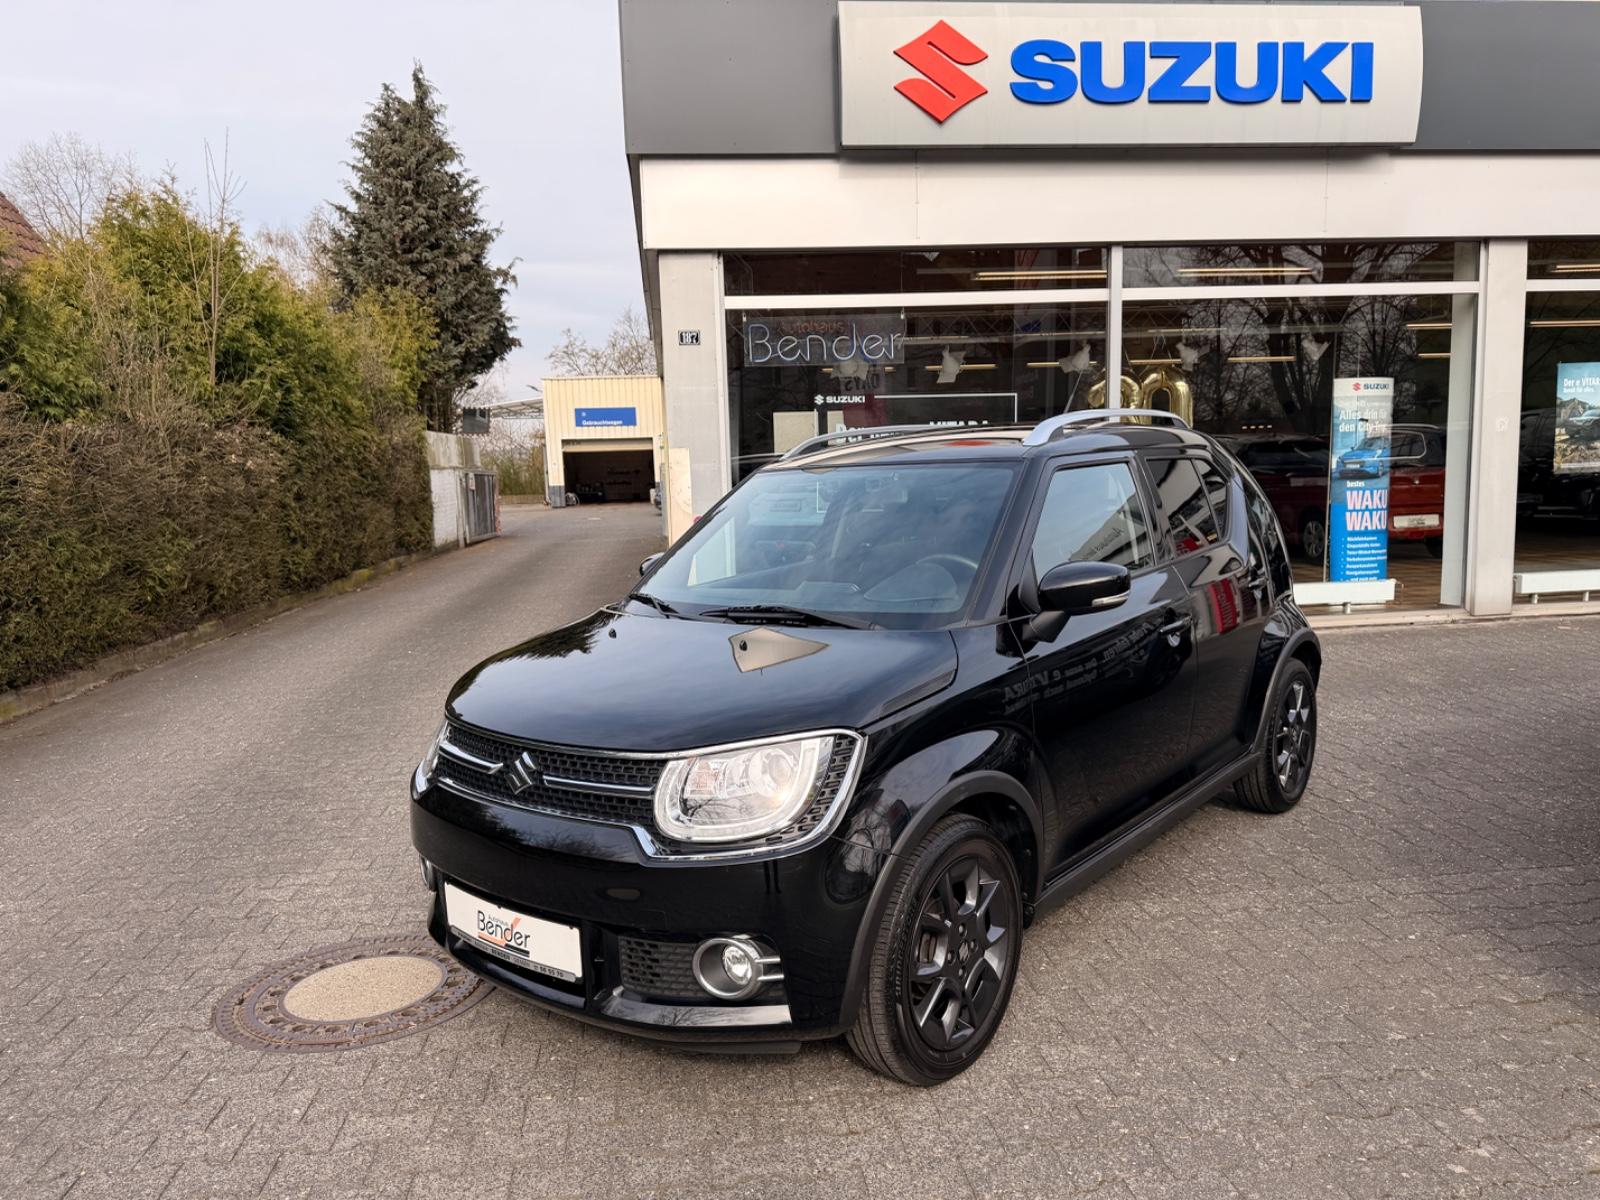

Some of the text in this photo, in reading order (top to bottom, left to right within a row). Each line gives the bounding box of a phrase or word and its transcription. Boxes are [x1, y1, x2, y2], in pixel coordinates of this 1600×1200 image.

[1009, 38, 1374, 105] SUZUKI
[748, 322, 903, 363] Bender
[825, 395, 866, 404] SUZUKI
[1339, 409, 1361, 421] Alles
[1339, 422, 1355, 433] den
[1346, 489, 1388, 511] WAKU
[1345, 510, 1387, 531] WAKU
[477, 910, 531, 948] Bender
